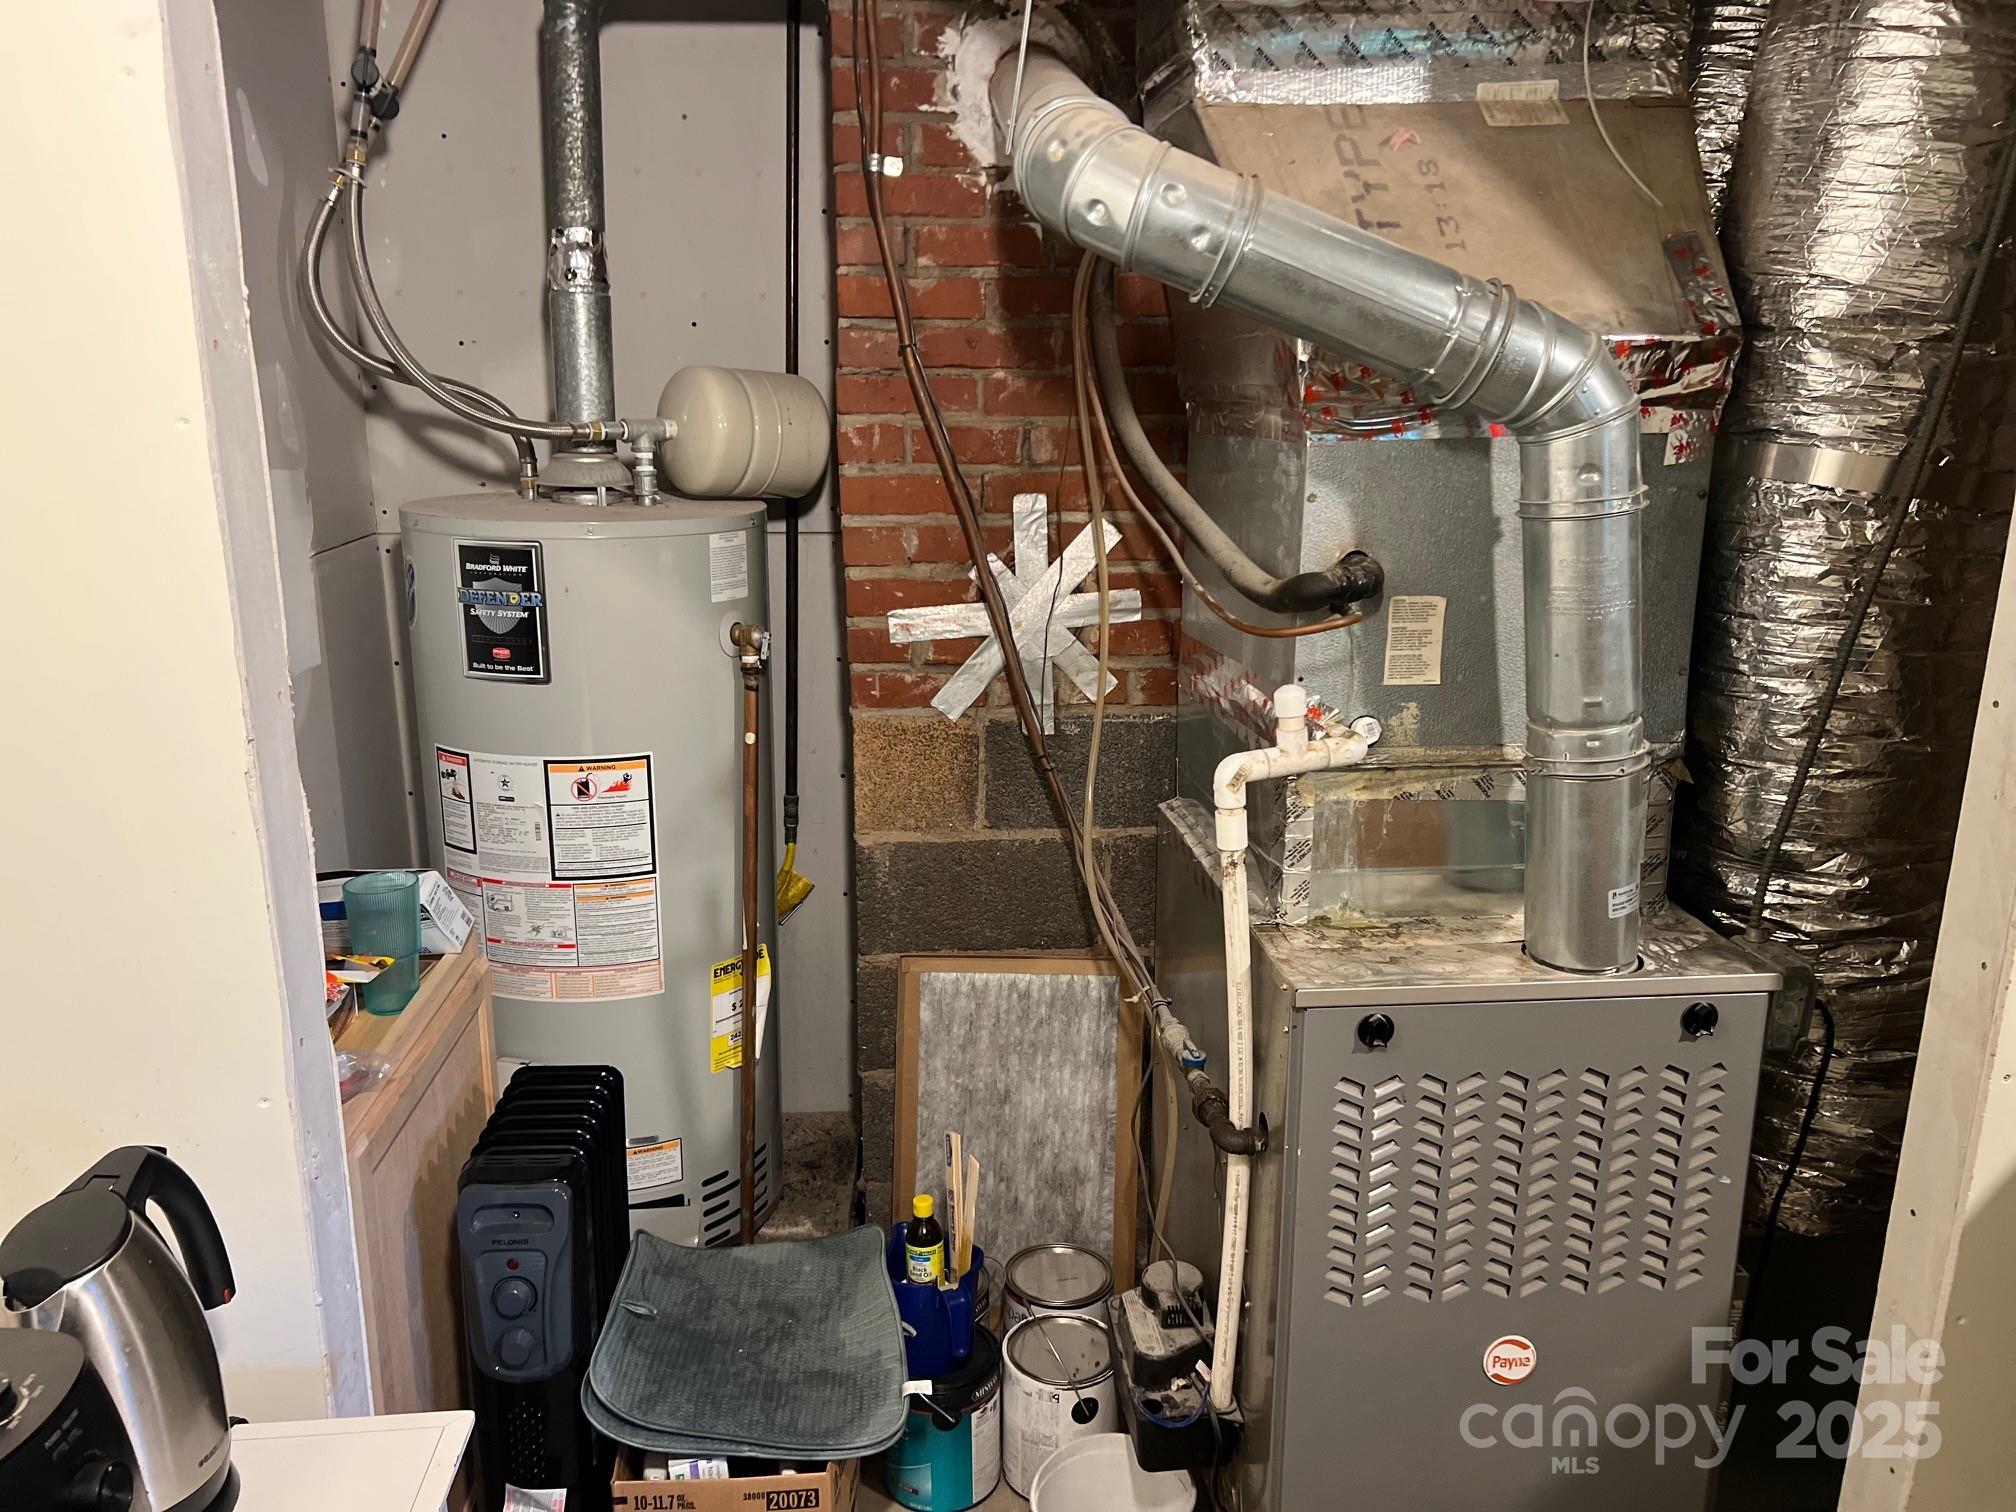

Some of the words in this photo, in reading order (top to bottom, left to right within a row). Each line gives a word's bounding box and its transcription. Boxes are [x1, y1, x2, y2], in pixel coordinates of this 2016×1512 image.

[465, 562, 501, 573] BRADFORD
[502, 564, 529, 573] WHITE
[457, 587, 543, 607] DEFENDER
[470, 607, 496, 617] SAFETY
[497, 609, 530, 619] SYSTEM
[473, 662, 487, 670] Built
[487, 662, 494, 670] to
[494, 663, 504, 671] be
[505, 664, 516, 672] the
[517, 664, 535, 672] Best
[586, 764, 616, 772] WARNING
[637, 1146, 664, 1155] WARNING
[1491, 1352, 1531, 1371] Payne
[634, 1495, 675, 1511] 10-11.7
[768, 1491, 816, 1510] 20073
